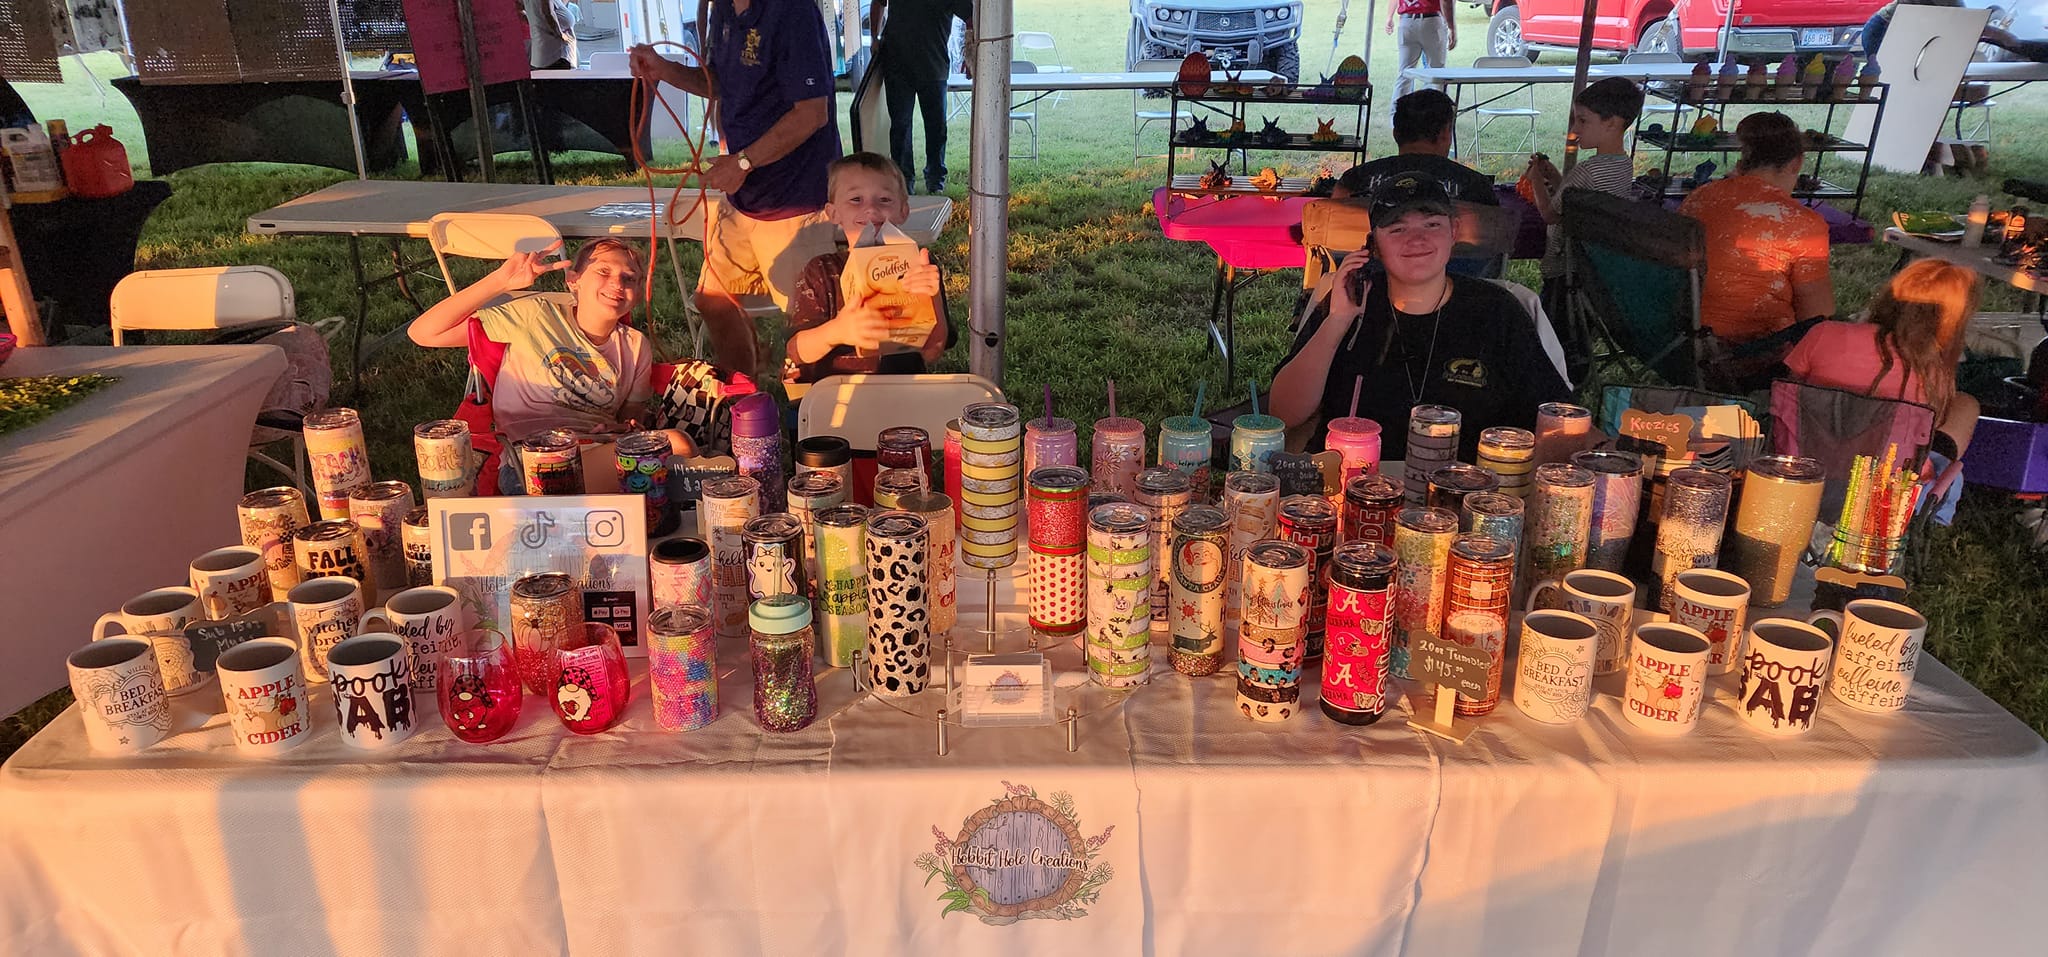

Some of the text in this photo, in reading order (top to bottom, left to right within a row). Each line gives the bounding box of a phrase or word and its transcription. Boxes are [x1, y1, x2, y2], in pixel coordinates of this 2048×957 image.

[871, 259, 910, 281] Goldfish
[308, 546, 357, 570] FALL
[718, 550, 746, 566] hell
[227, 568, 269, 594] APPLE
[836, 575, 868, 590] HAPPY
[832, 586, 868, 605] apple
[828, 600, 868, 616] SEASON
[1681, 601, 1734, 622] APPLE
[436, 614, 456, 638] by
[616, 622, 630, 630] VISA
[1419, 640, 1444, 655] 20oz
[1845, 622, 1919, 657] fueled by
[1536, 660, 1573, 676] BED &
[1636, 653, 1691, 677] APPLE
[1461, 680, 1481, 691] each
[1523, 665, 1585, 687] BREAKFAST
[120, 685, 146, 702] BED
[237, 675, 295, 700] APPLE
[105, 683, 166, 716] BREAKFAS
[1629, 698, 1679, 722] CIDER
[247, 724, 302, 745] CIDER
[951, 847, 1090, 873] Hobbit Hole Creations
